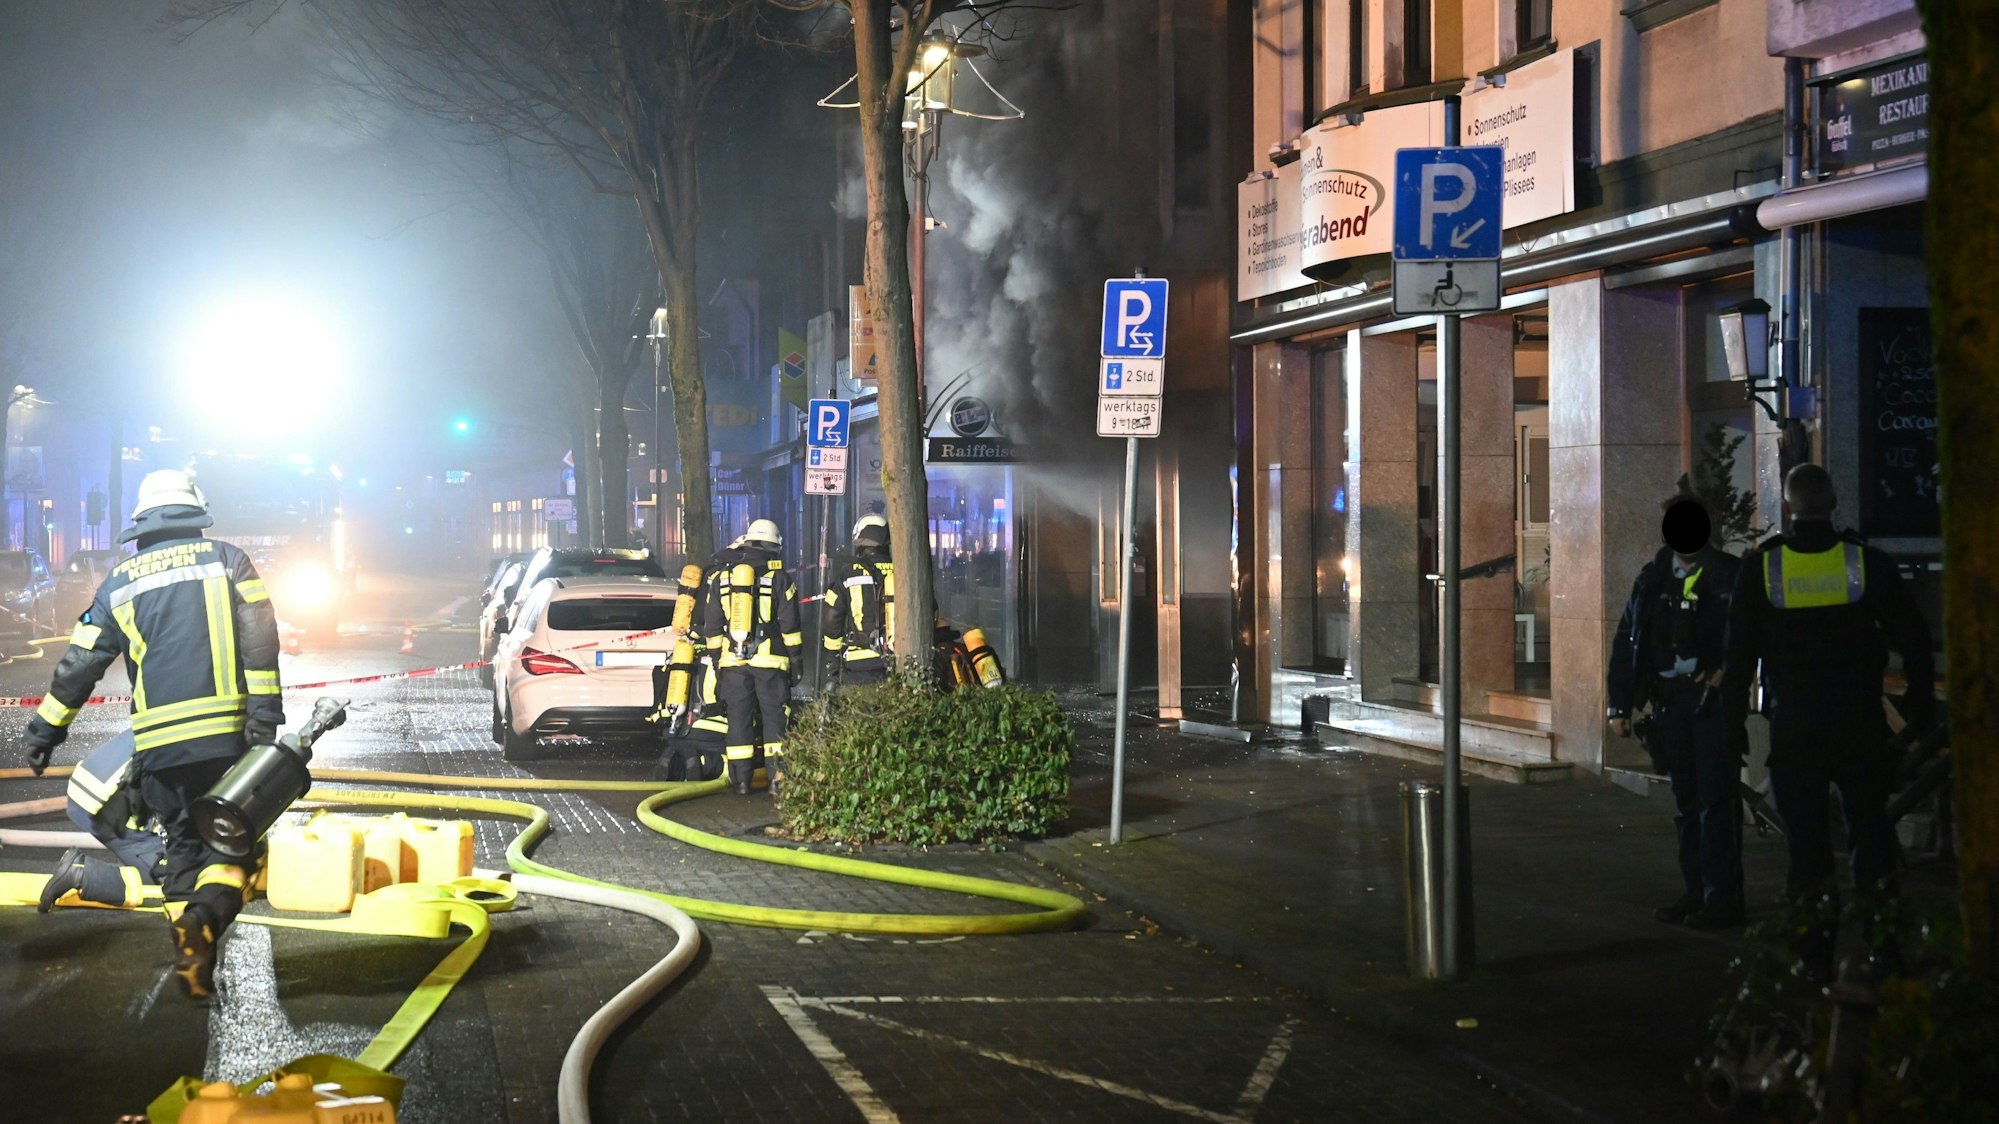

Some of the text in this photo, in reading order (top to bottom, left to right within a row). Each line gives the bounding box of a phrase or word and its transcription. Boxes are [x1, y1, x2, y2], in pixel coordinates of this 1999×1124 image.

[1871, 63, 1928, 96] MEXIKANI
[1474, 104, 1527, 136] Sonnenschutz
[1879, 93, 1930, 125] RESTAUR
[1503, 177, 1535, 198] Plissees
[1419, 163, 1477, 247] P
[1117, 290, 1152, 347] P
[1126, 370, 1156, 382] 2 Std.
[817, 405, 840, 441] P
[1104, 400, 1156, 415] werktags
[823, 454, 828, 462] 2
[112, 541, 213, 578] FEUERWEHR
[128, 553, 196, 582] KERPEN
